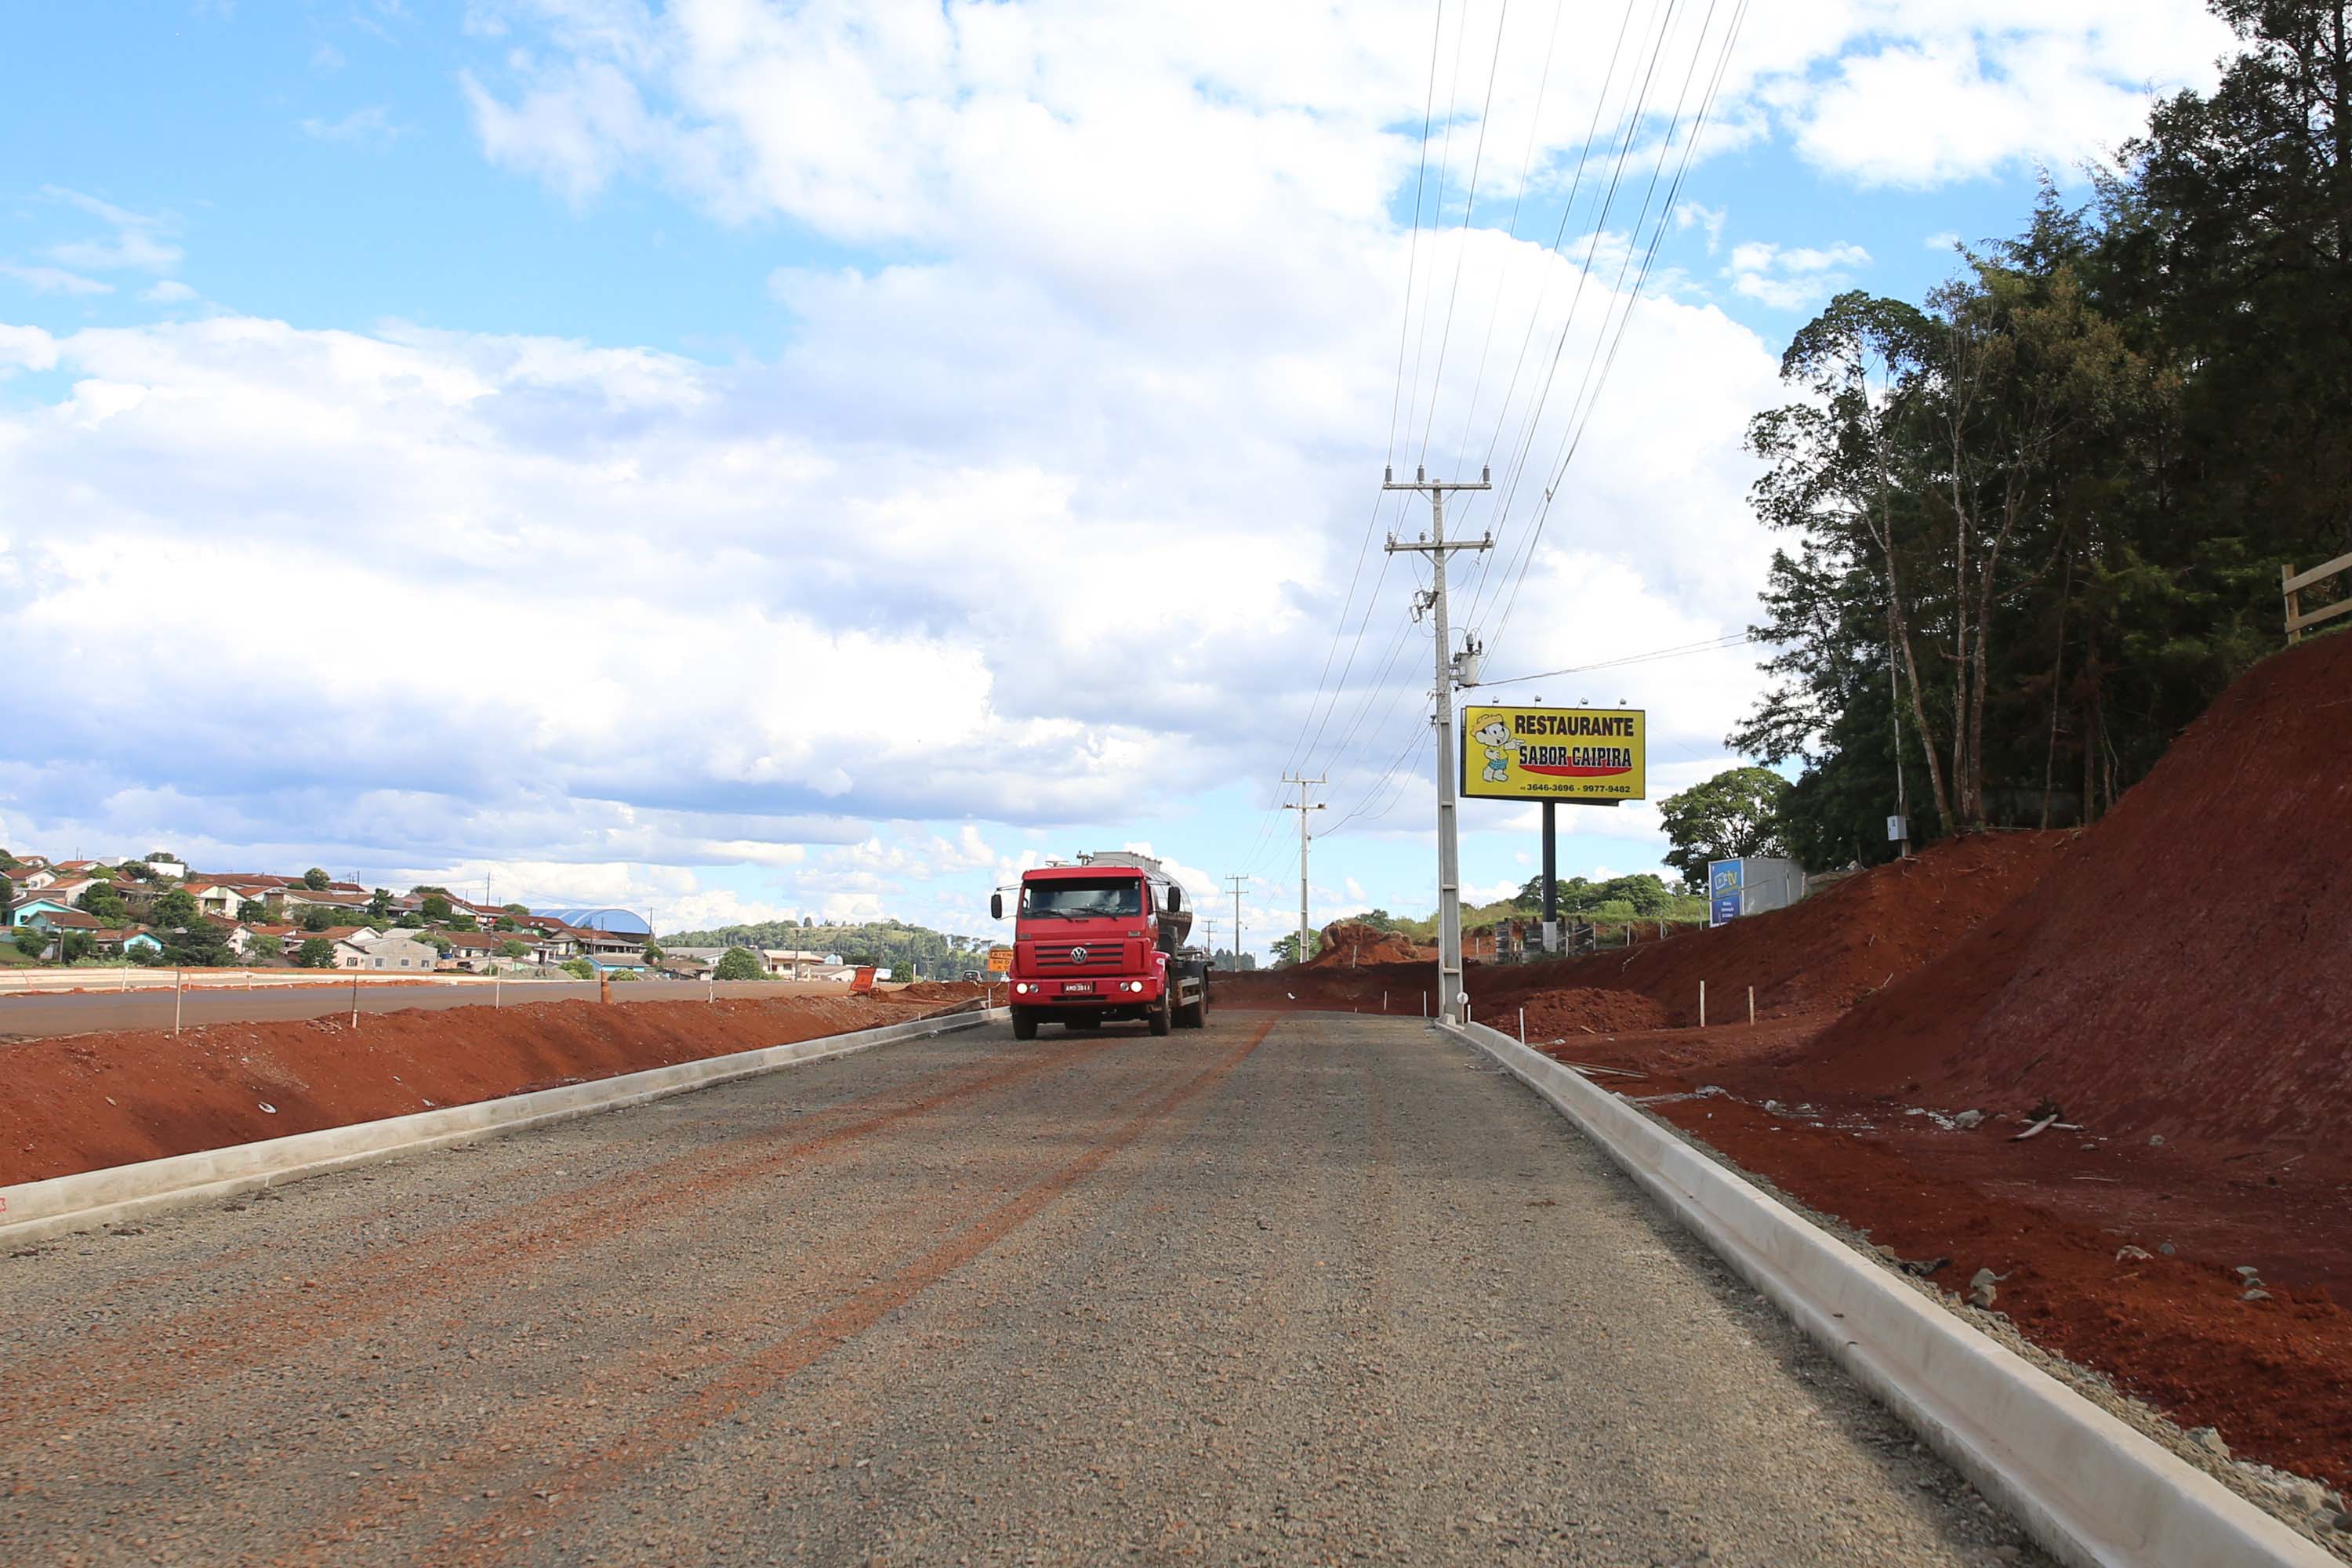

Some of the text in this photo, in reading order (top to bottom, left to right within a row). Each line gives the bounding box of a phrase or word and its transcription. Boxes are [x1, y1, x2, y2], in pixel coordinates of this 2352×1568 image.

[1515, 715, 1634, 737] RESTAURANTE
[1519, 746, 1632, 767] SABOR CAIPIRA
